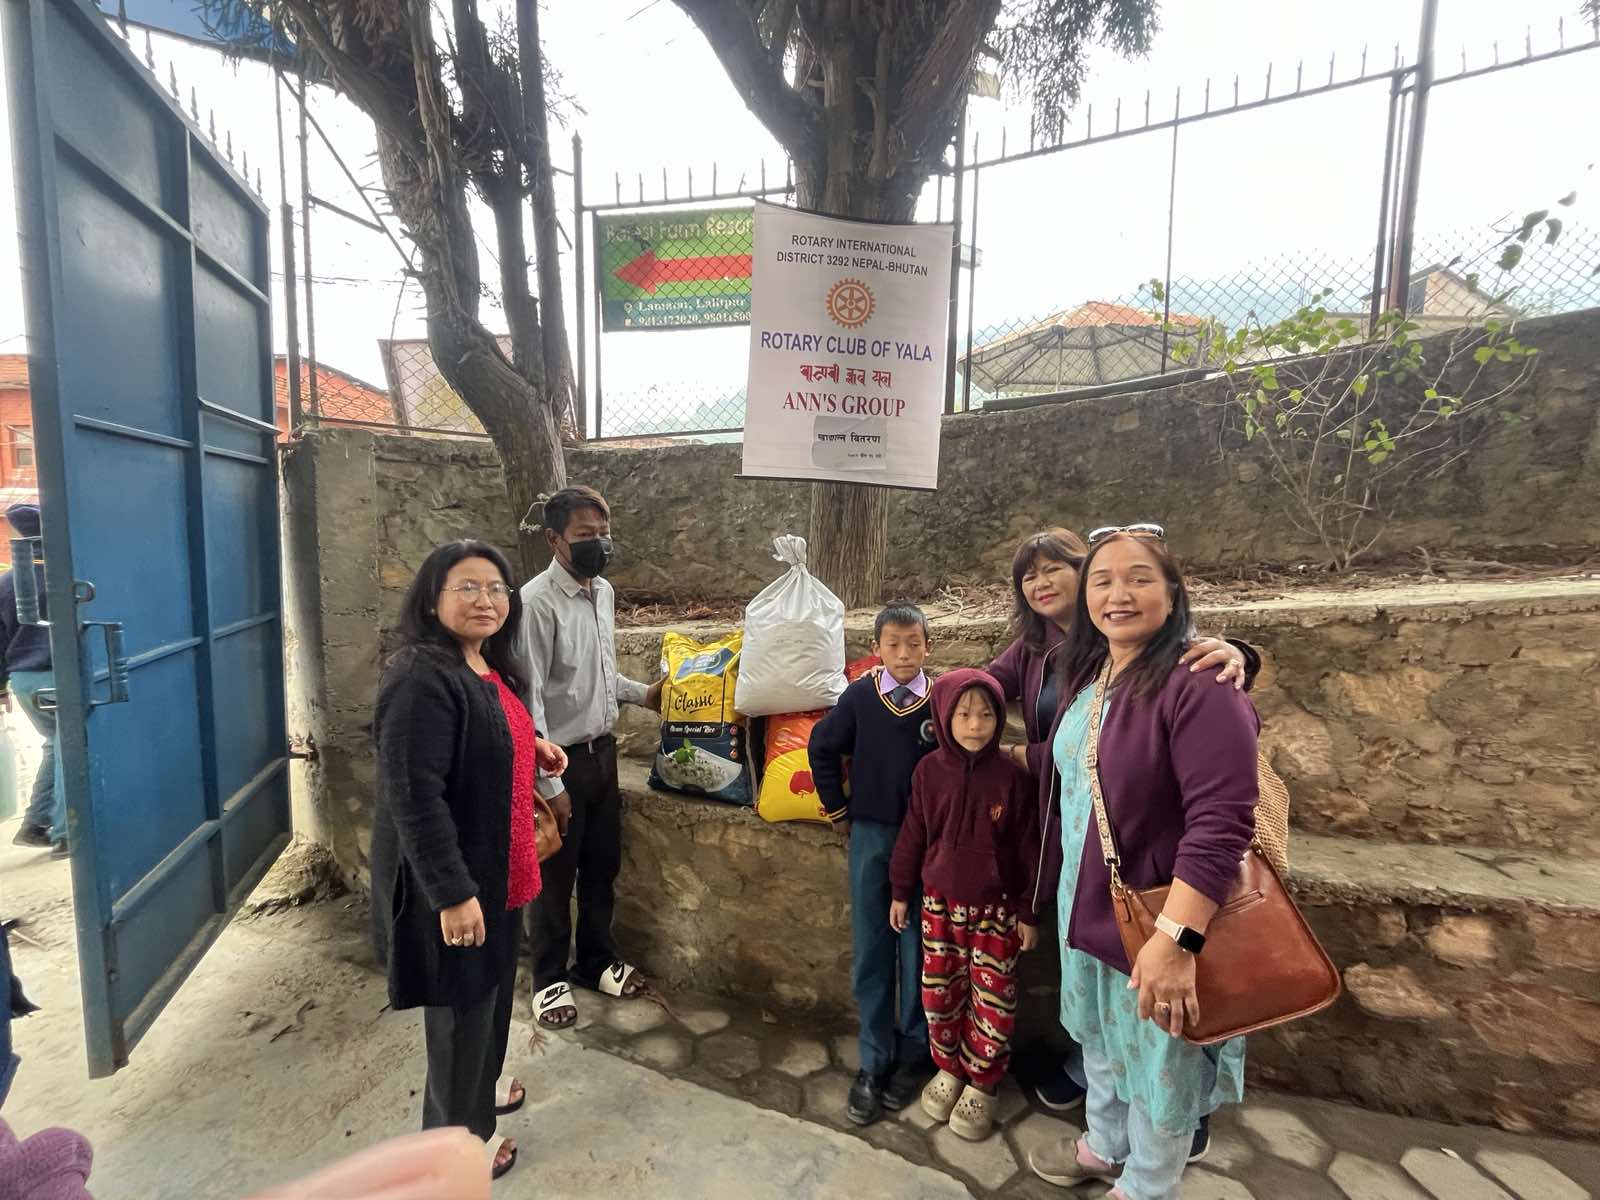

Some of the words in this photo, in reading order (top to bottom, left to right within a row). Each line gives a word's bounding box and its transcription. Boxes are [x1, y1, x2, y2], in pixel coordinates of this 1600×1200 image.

[792, 234, 834, 248] ROTARY
[837, 238, 917, 258] INTERNATIONAL
[777, 251, 824, 265] DISTRICT
[827, 255, 850, 267] 3292
[852, 258, 928, 277] NEPAL-BHUTAN
[761, 331, 823, 351] ROTARY
[826, 336, 866, 356] CLUB
[871, 340, 892, 358] OF
[895, 343, 933, 362] YALA
[783, 391, 837, 413] ANN'S
[841, 395, 906, 417] GROUP
[674, 690, 715, 712] Classic
[544, 984, 566, 1000] NIKE
